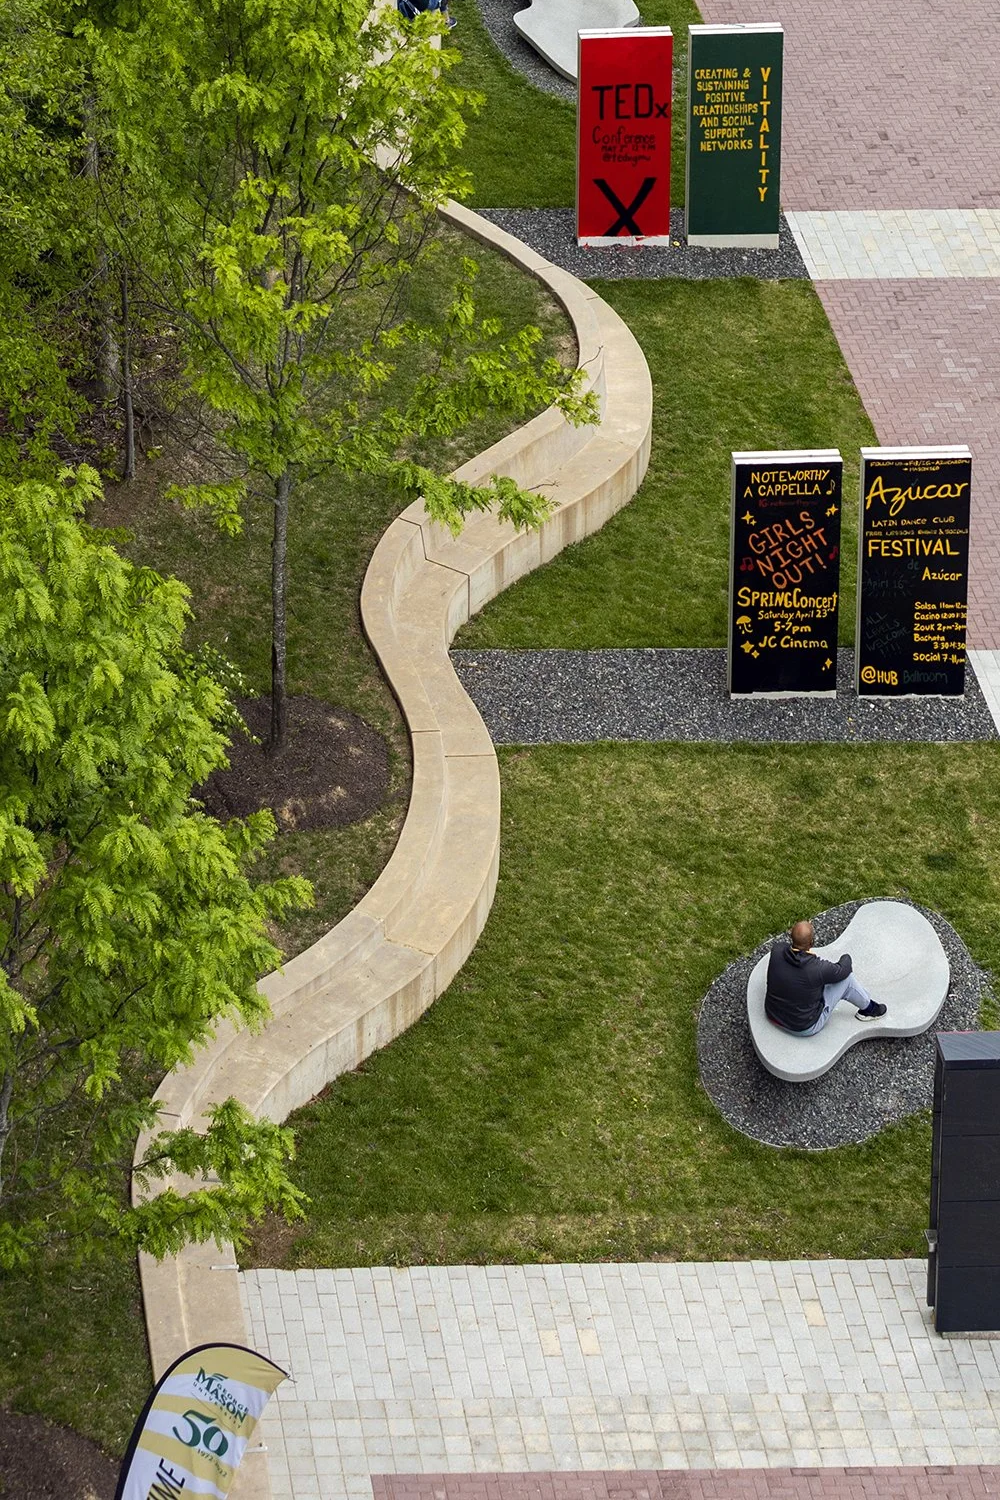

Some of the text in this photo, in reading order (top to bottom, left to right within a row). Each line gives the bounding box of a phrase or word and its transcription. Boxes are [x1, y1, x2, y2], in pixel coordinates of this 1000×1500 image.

[694, 67, 752, 79] CREATING &
[696, 80, 750, 92] SUSTAINING
[591, 83, 669, 121] TEDx
[705, 91, 746, 103] POSITIVE
[693, 103, 758, 116] RELATIONSHIPS
[700, 115, 755, 128] AND SOCIAL
[704, 127, 745, 139] SUPPORT
[758, 67, 771, 202] VITALITY
[700, 139, 753, 151] NETWORKS
[592, 177, 658, 237] X
[751, 469, 831, 484] NOTEWORTHY
[743, 483, 822, 498] A CAPPELLA
[872, 520, 898, 528] LATIN
[932, 516, 956, 524] CLUB
[748, 511, 815, 555] GIRLS
[756, 527, 828, 577] NIGHT
[868, 538, 961, 558] FESTIVAL
[772, 553, 828, 590] OUT!
[922, 566, 963, 581] Azúcar
[914, 601, 937, 610] Salsa
[795, 610, 815, 621] April
[914, 611, 941, 620] Casino
[758, 635, 829, 649] JC Cinema
[913, 633, 946, 642] Bachata
[861, 665, 899, 686] @HUB
[195, 1366, 247, 1424] MASON
[216, 1383, 249, 1413] GEORGE
[172, 1409, 229, 1457] 50
